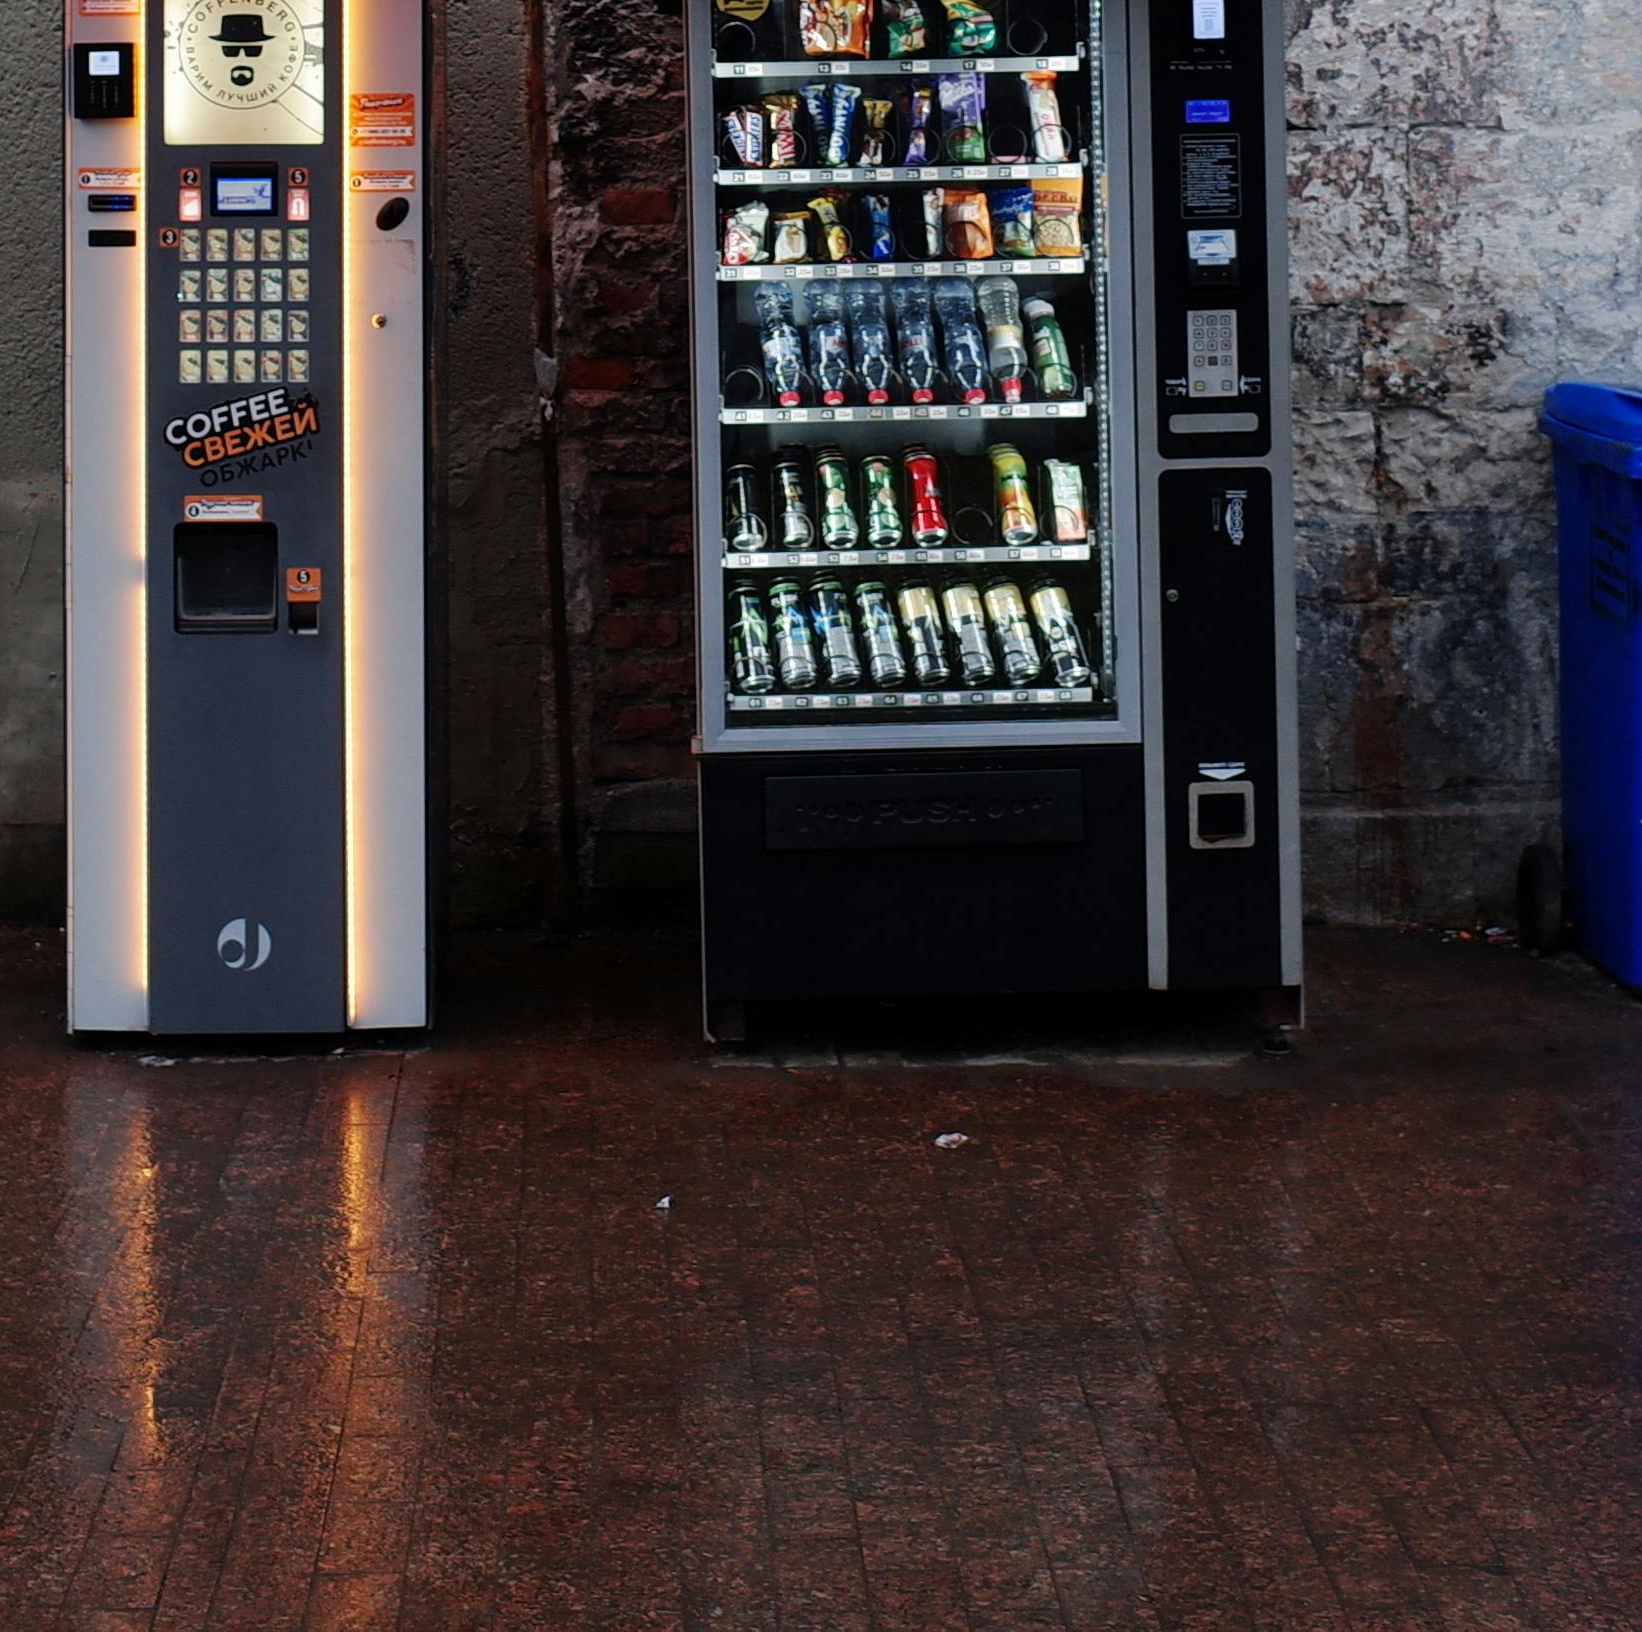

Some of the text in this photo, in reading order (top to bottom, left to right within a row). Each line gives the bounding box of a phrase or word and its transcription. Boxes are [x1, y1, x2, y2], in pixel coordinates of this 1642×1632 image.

[216, 83, 277, 102] ЛУЧШИЙ
[278, 45, 298, 83] КОФЕ
[775, 109, 797, 163] TWIX
[828, 95, 850, 162] BOUNTY
[165, 388, 289, 445] COFFEE
[183, 402, 318, 467] СВЕЖЕЙ
